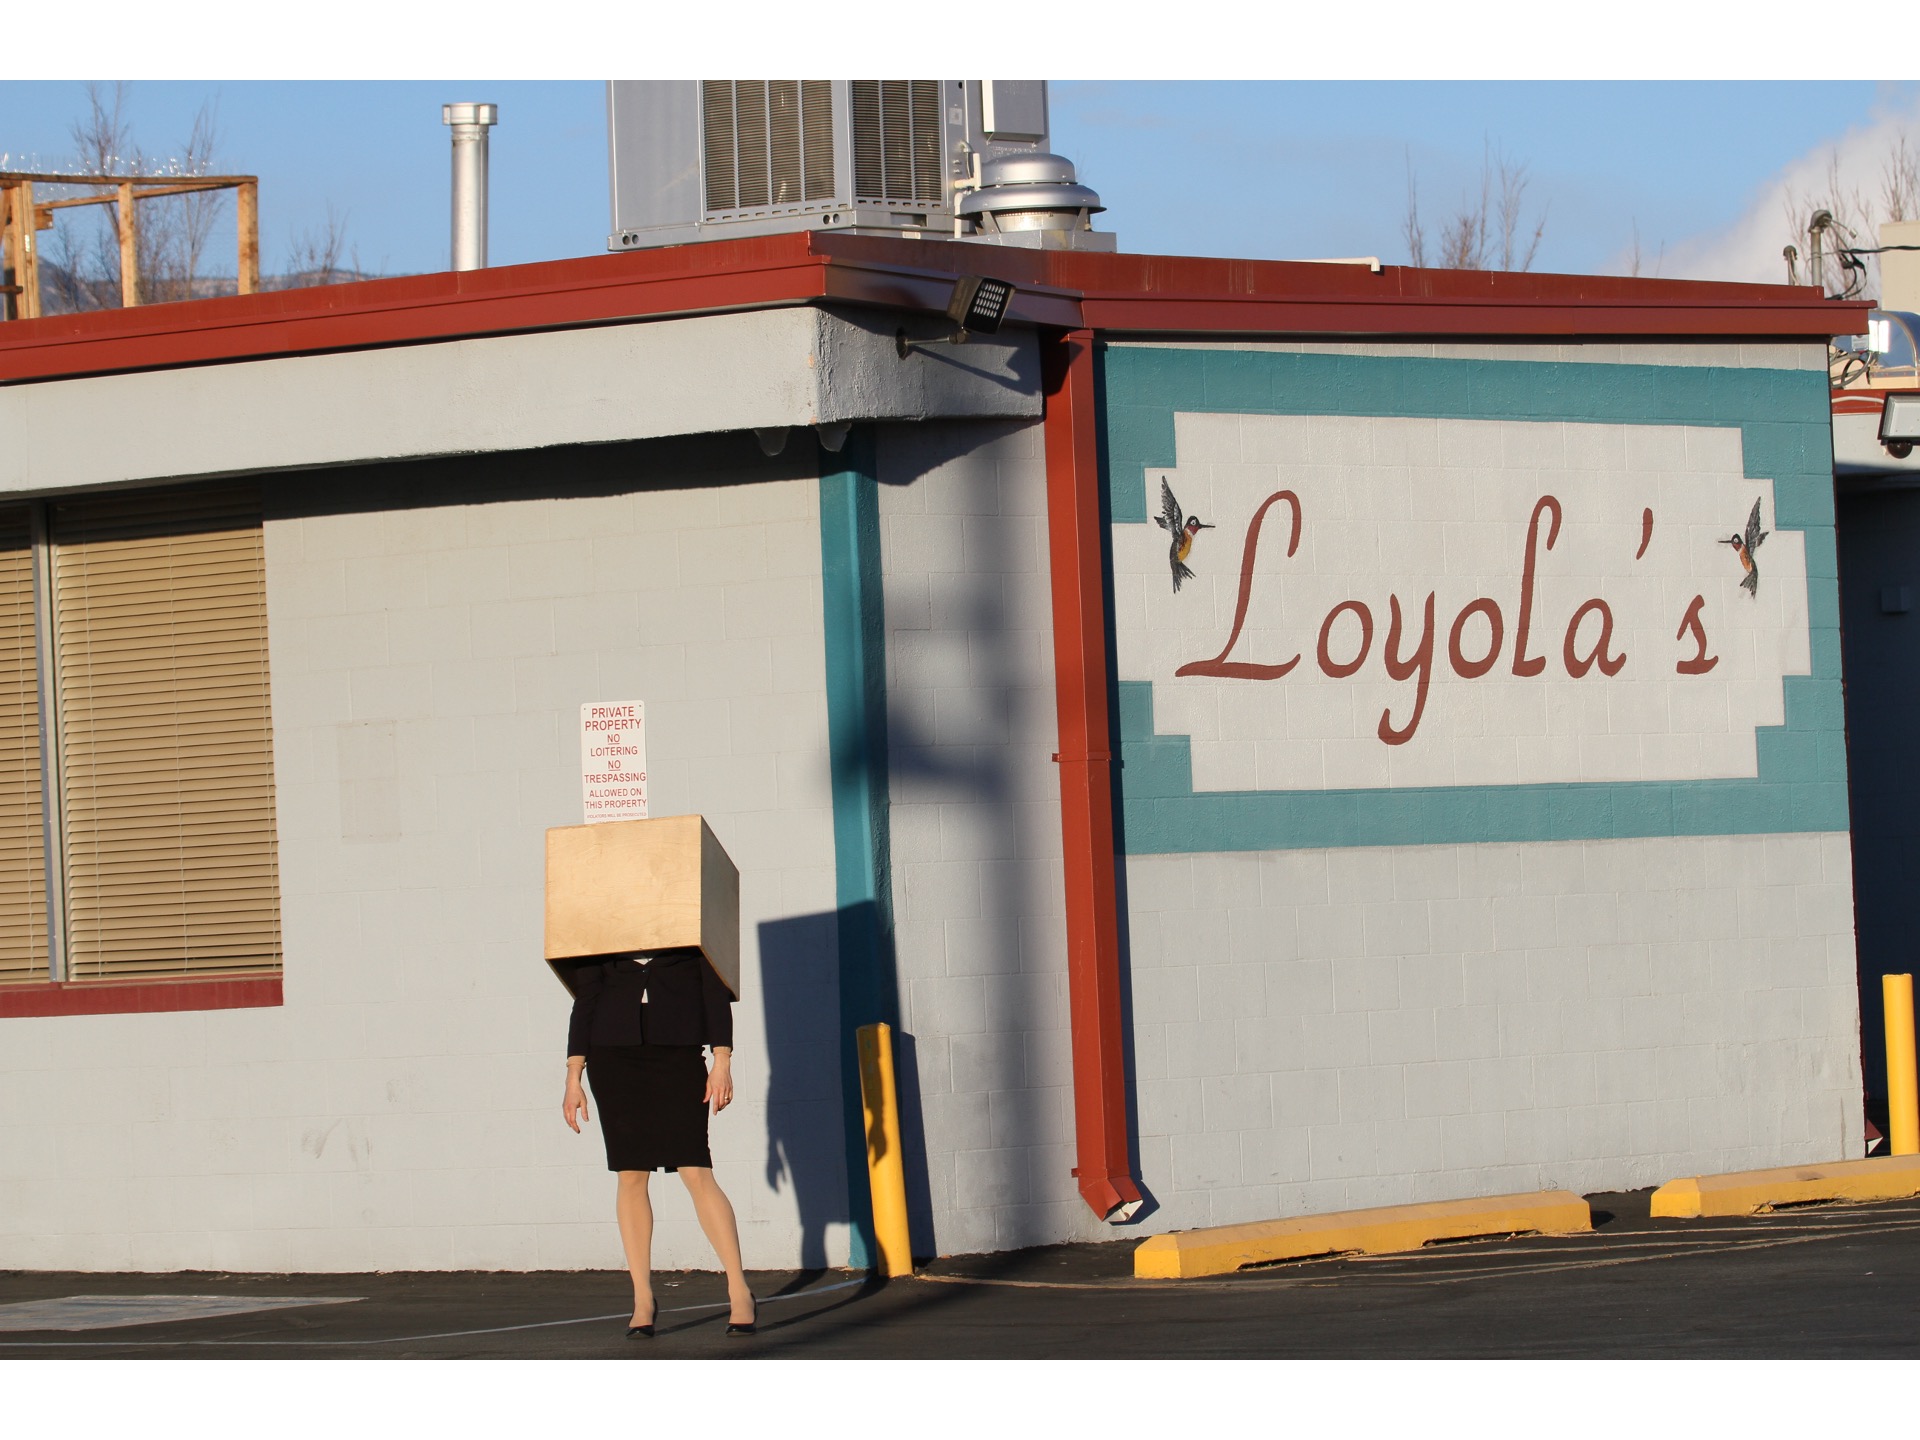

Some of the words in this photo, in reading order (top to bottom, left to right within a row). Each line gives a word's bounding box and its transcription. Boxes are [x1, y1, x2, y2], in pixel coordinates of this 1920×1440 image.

[1175, 489, 1719, 745] Loyola's
[591, 706, 635, 719] PRIVATE
[585, 718, 642, 731] PROPERTY
[607, 733, 621, 743] NO
[590, 746, 638, 757] LOITERING
[608, 760, 621, 769] NO
[584, 772, 647, 784] TRESPASSING
[589, 788, 628, 798] ALLOWED
[630, 788, 642, 796] ON
[585, 801, 602, 809] THIS
[604, 799, 647, 809] PROPERTY
